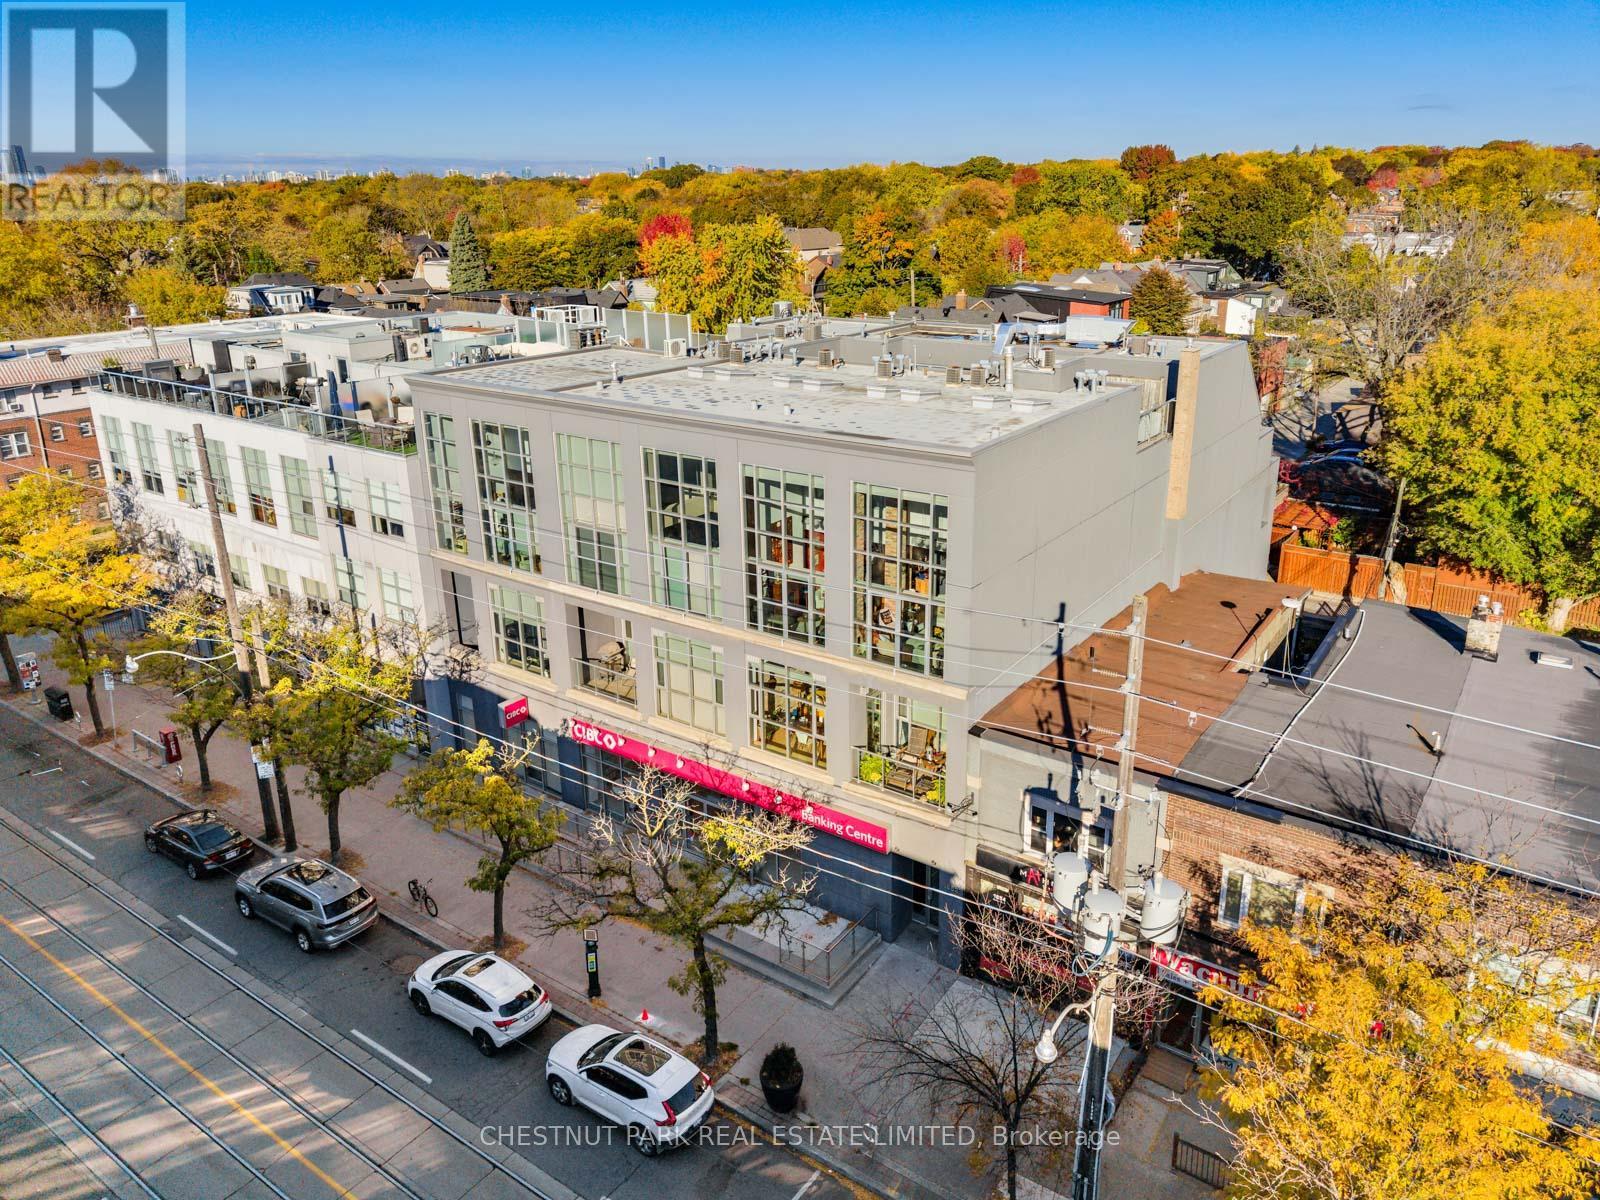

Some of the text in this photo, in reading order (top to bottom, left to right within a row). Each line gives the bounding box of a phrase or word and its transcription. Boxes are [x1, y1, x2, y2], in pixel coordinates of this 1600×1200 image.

[506, 708, 521, 720] CIBC
[574, 723, 603, 746] CIBC
[801, 810, 884, 848] Banking Centre
